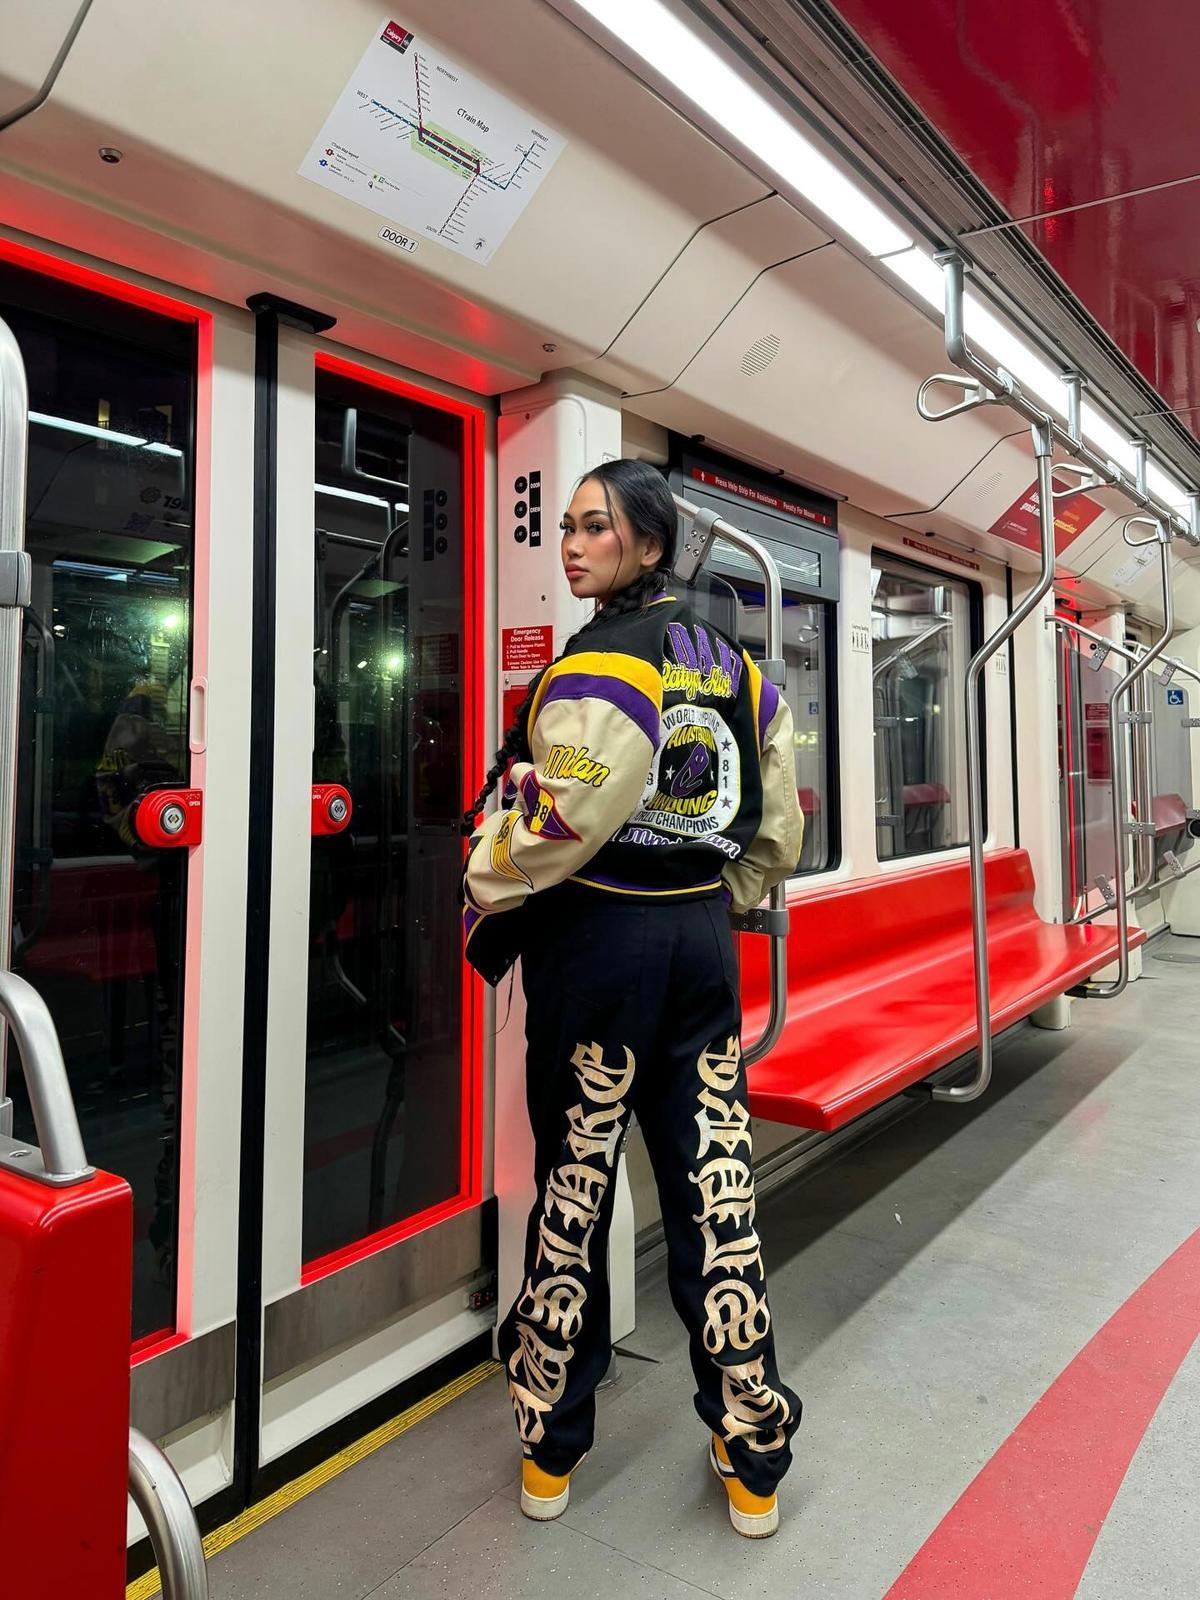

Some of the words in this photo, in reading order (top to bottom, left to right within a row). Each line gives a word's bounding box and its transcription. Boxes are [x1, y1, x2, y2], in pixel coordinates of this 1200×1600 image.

[386, 28, 402, 43] Calgary
[436, 66, 459, 82] NORTHWEST
[356, 90, 369, 100] WEST
[456, 108, 477, 126] CTrain
[476, 120, 490, 133] Map
[382, 229, 409, 247] DOOR
[410, 242, 416, 250] 1
[715, 476, 728, 489] Press
[655, 812, 719, 834] CHAMPIONS
